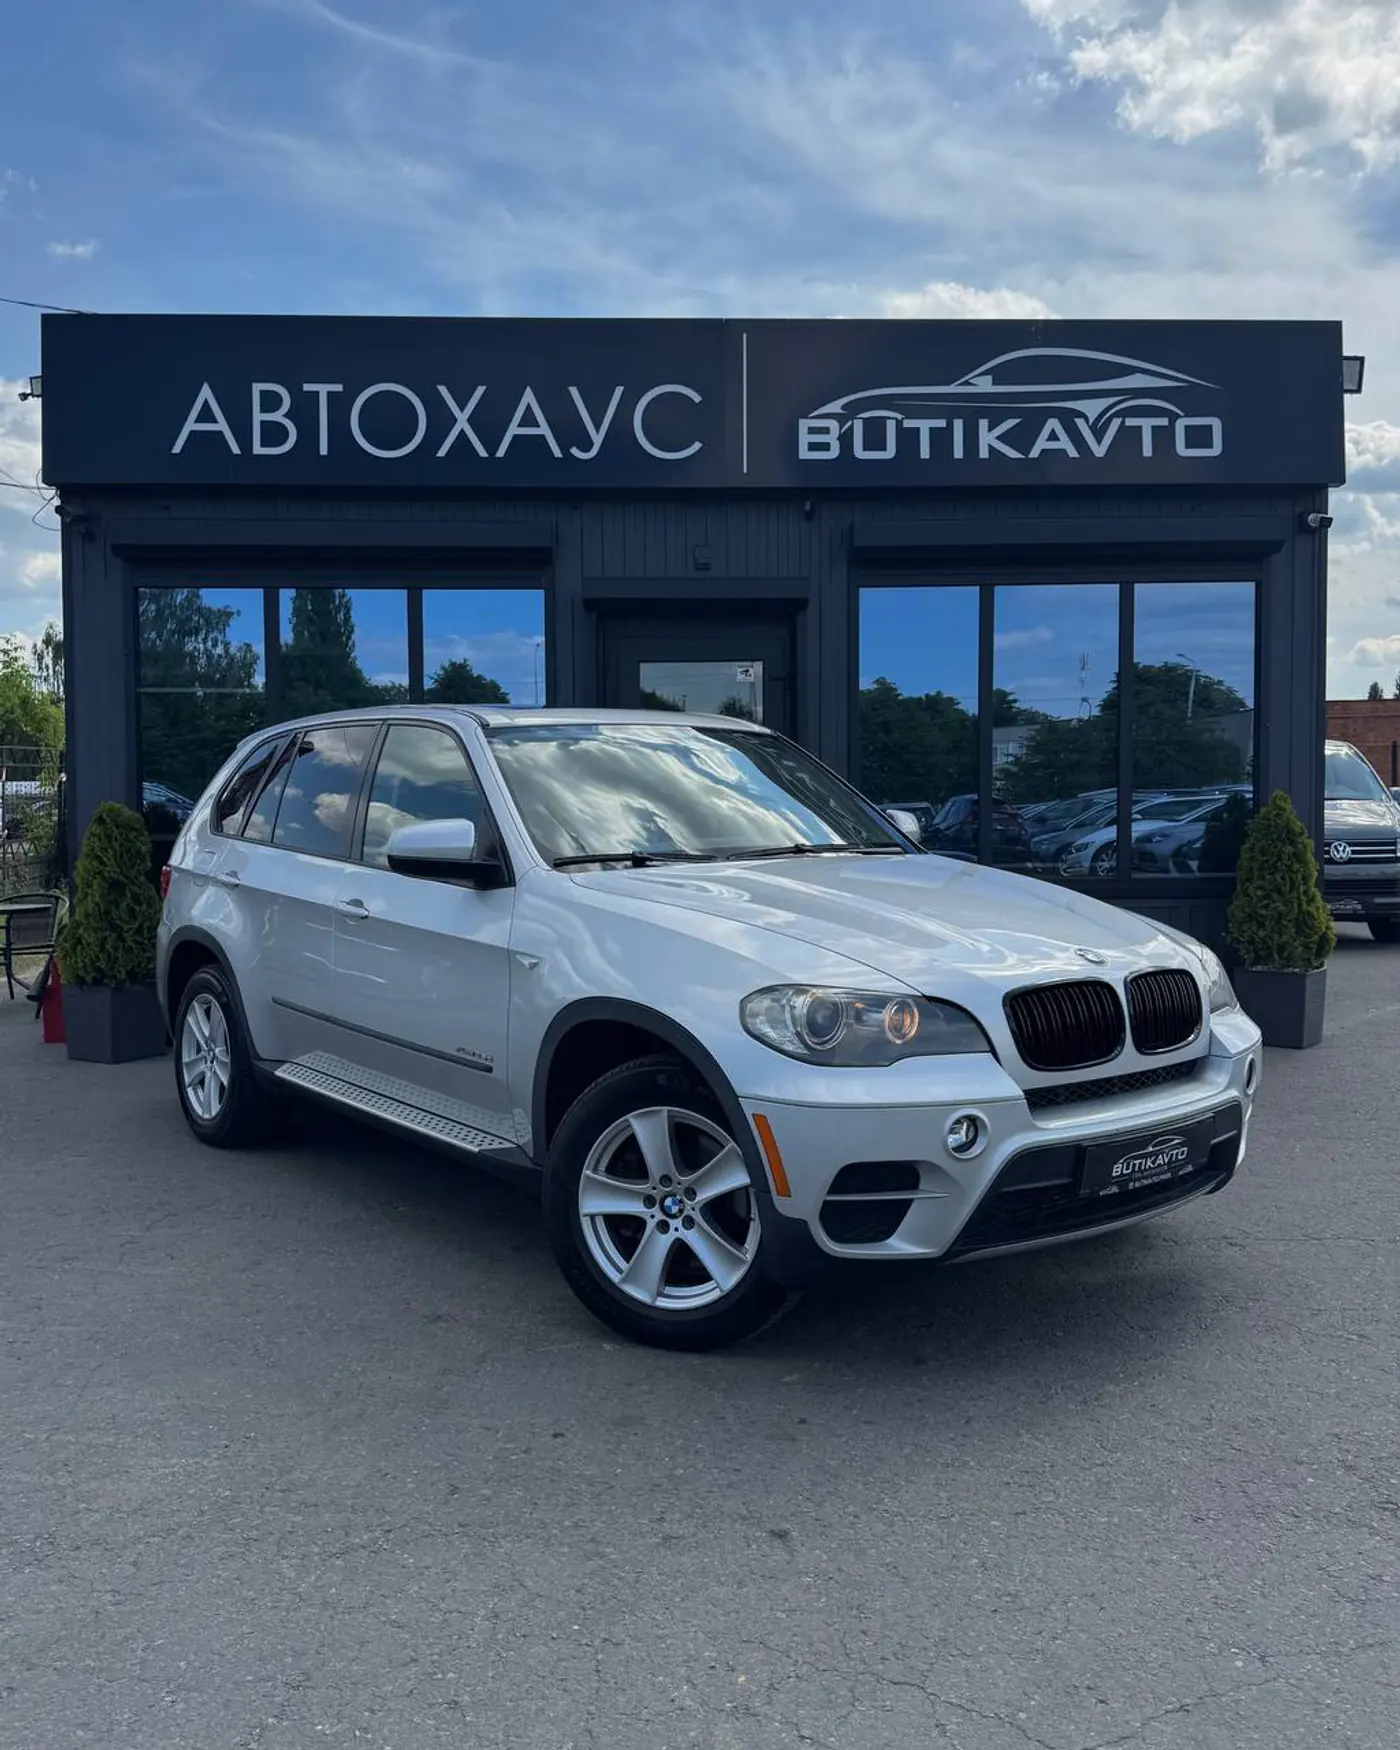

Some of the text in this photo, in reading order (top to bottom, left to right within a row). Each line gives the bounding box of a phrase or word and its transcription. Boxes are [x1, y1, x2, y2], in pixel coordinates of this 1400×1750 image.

[171, 382, 702, 460] АВТОХАУС
[798, 415, 1223, 460] BUTIKAVTO
[1111, 1147, 1188, 1176] BUTIKAVTO
